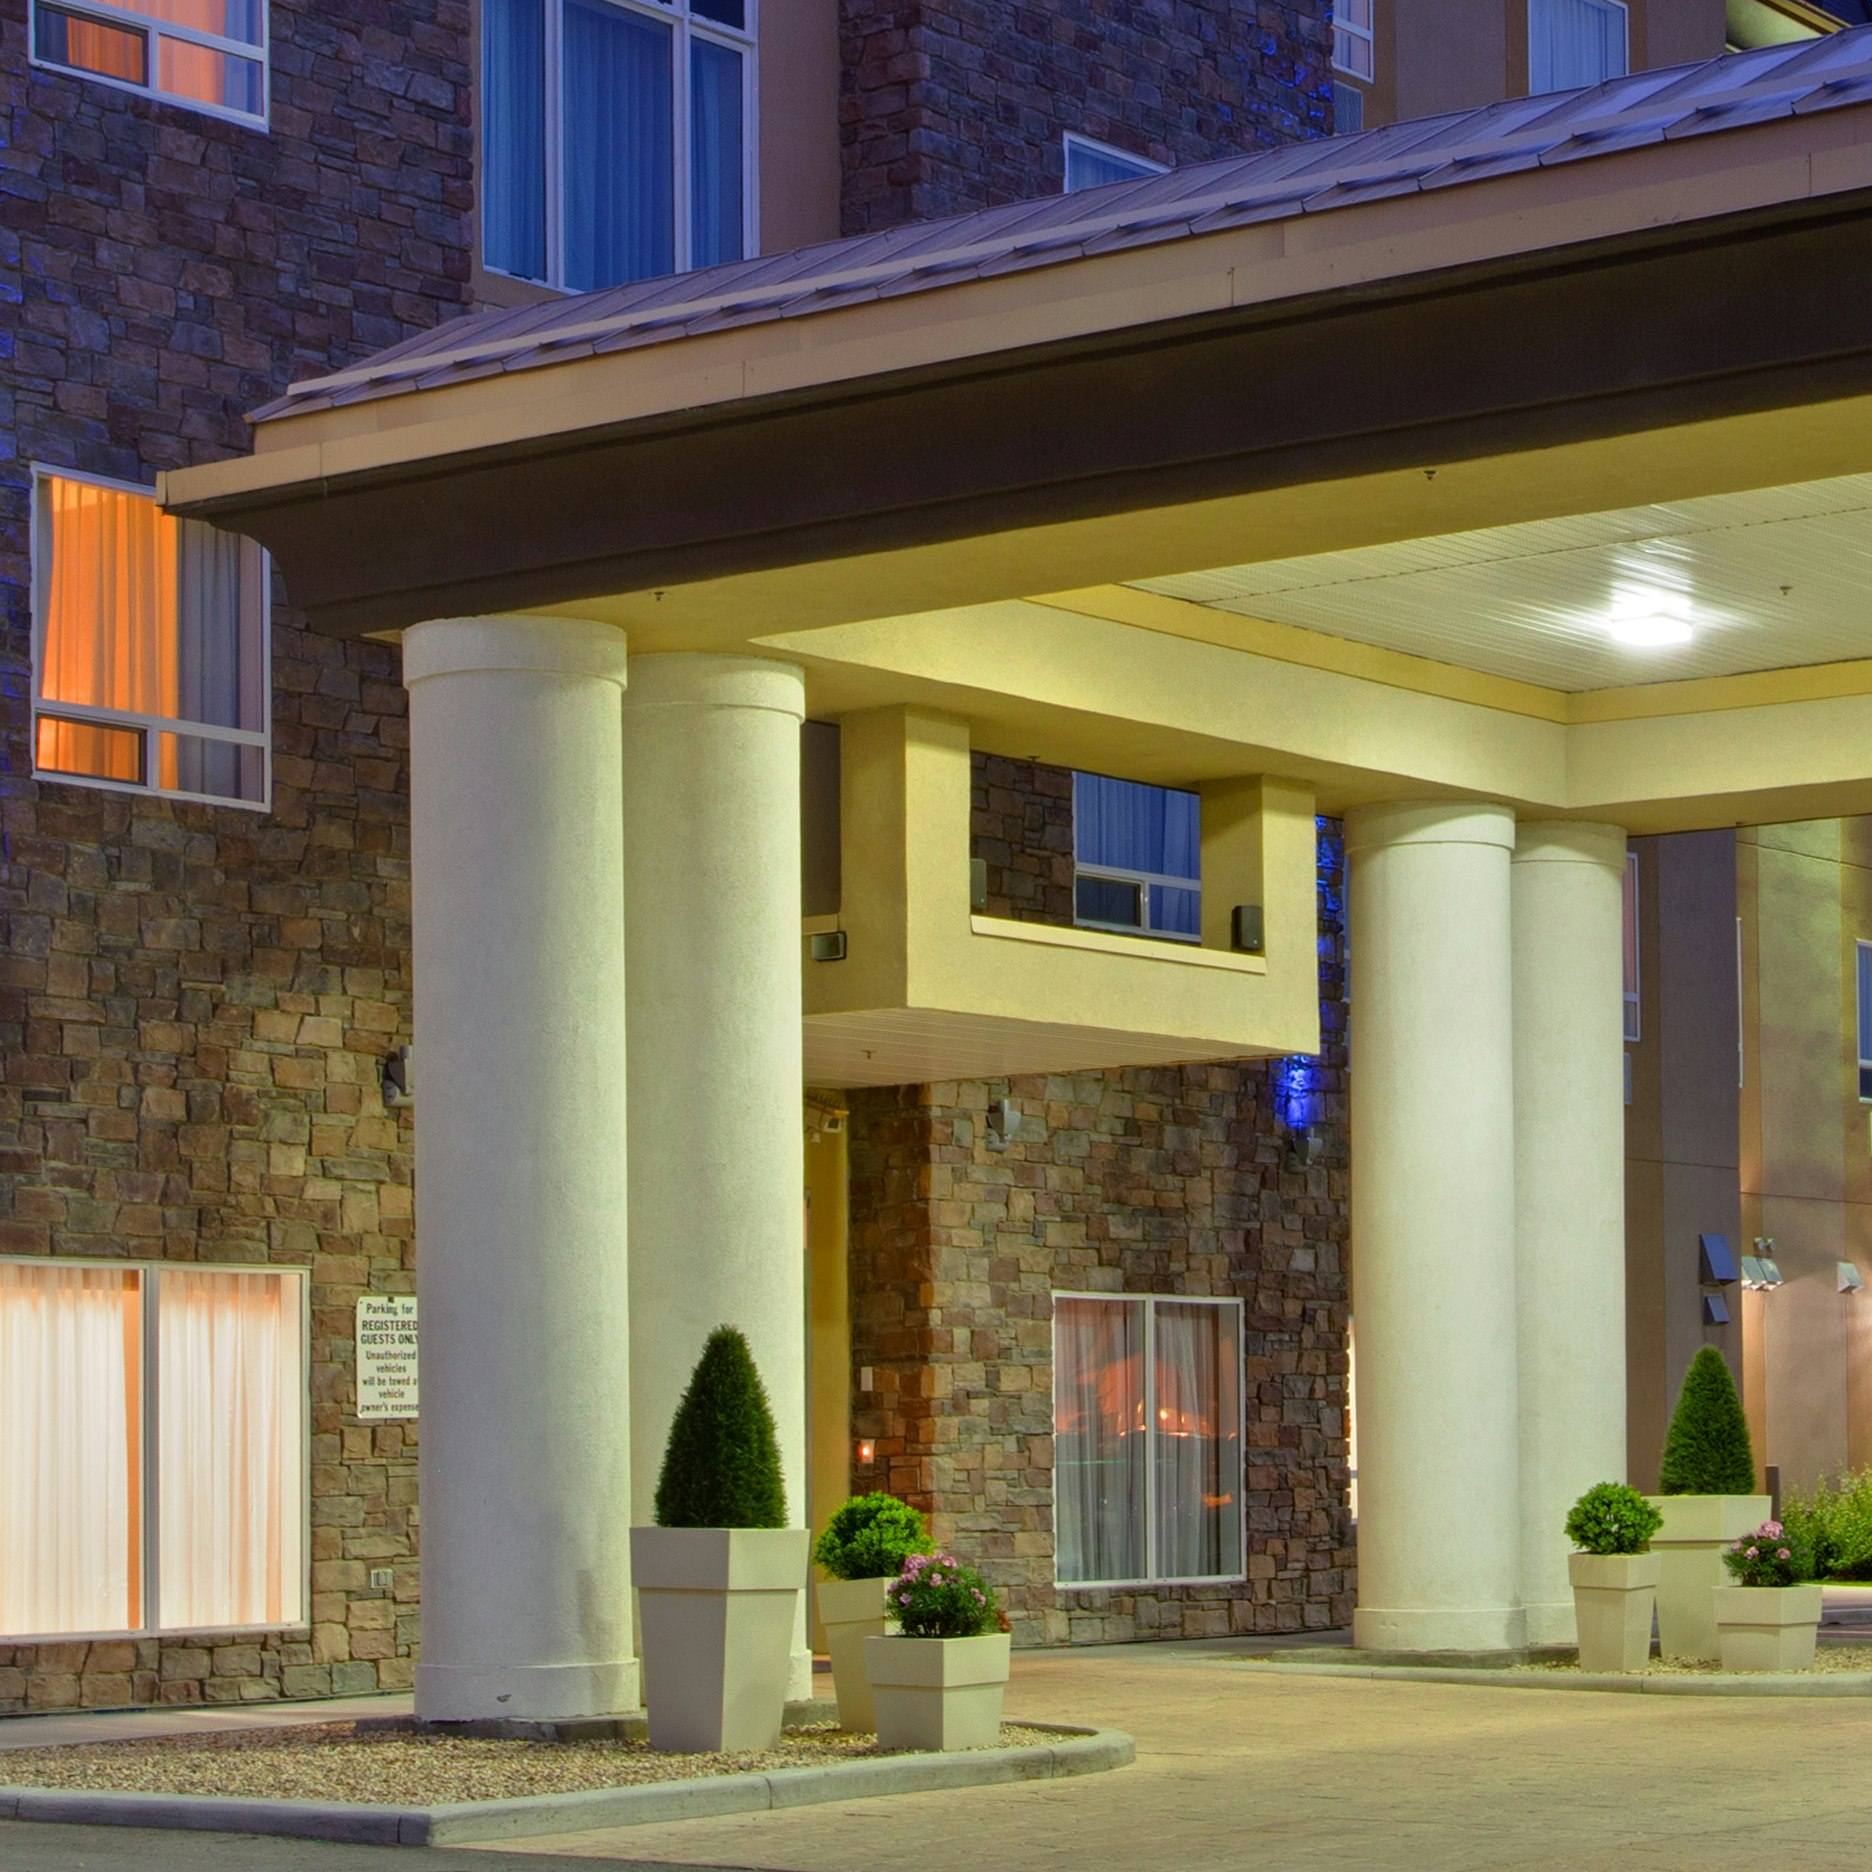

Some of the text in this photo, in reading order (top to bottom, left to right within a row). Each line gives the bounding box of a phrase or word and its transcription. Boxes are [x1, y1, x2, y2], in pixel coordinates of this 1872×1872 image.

[366, 1303, 414, 1316] Parking for
[361, 1320, 419, 1331] REGISTERED
[360, 1333, 396, 1345] GUESTS
[365, 1350, 416, 1360] Unauthorized
[376, 1363, 407, 1373] vehicles
[362, 1376, 375, 1386] will
[377, 1376, 386, 1386] be
[388, 1376, 410, 1386] towed
[378, 1389, 405, 1398] vehicle
